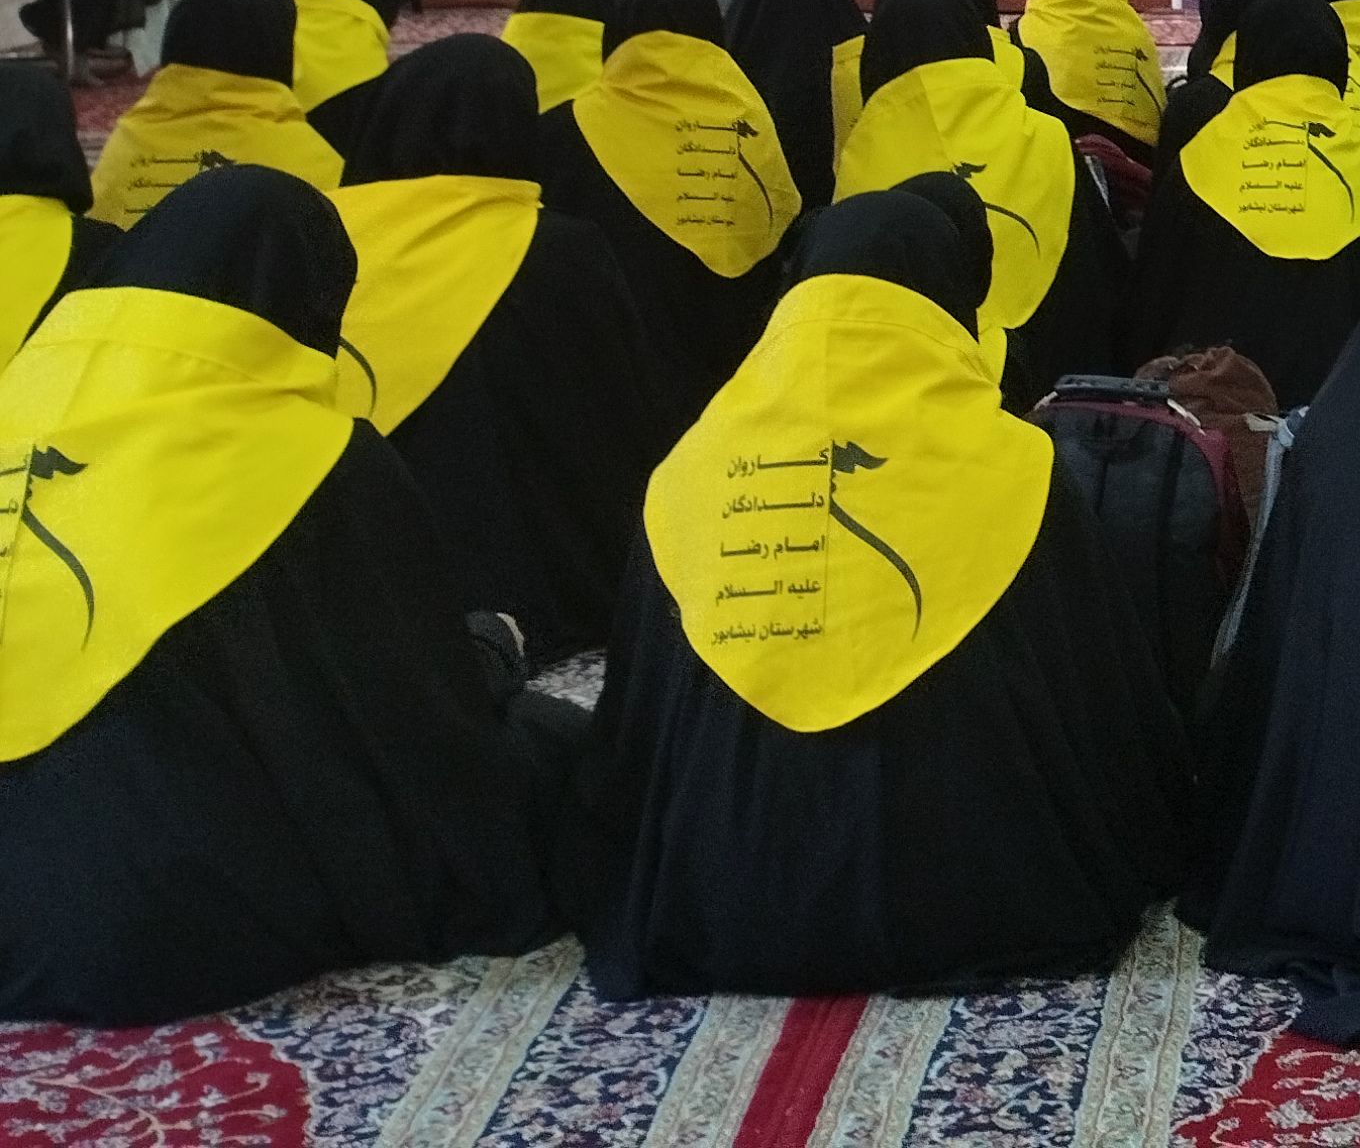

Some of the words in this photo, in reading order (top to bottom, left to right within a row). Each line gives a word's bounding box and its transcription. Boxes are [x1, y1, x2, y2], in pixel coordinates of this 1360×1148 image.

[727, 447, 829, 479] کاروان
[722, 492, 825, 519] دلدادگان
[720, 539, 769, 559] رضا
[773, 535, 826, 560] امام
[715, 580, 783, 606] السلام
[787, 579, 821, 599] علیه
